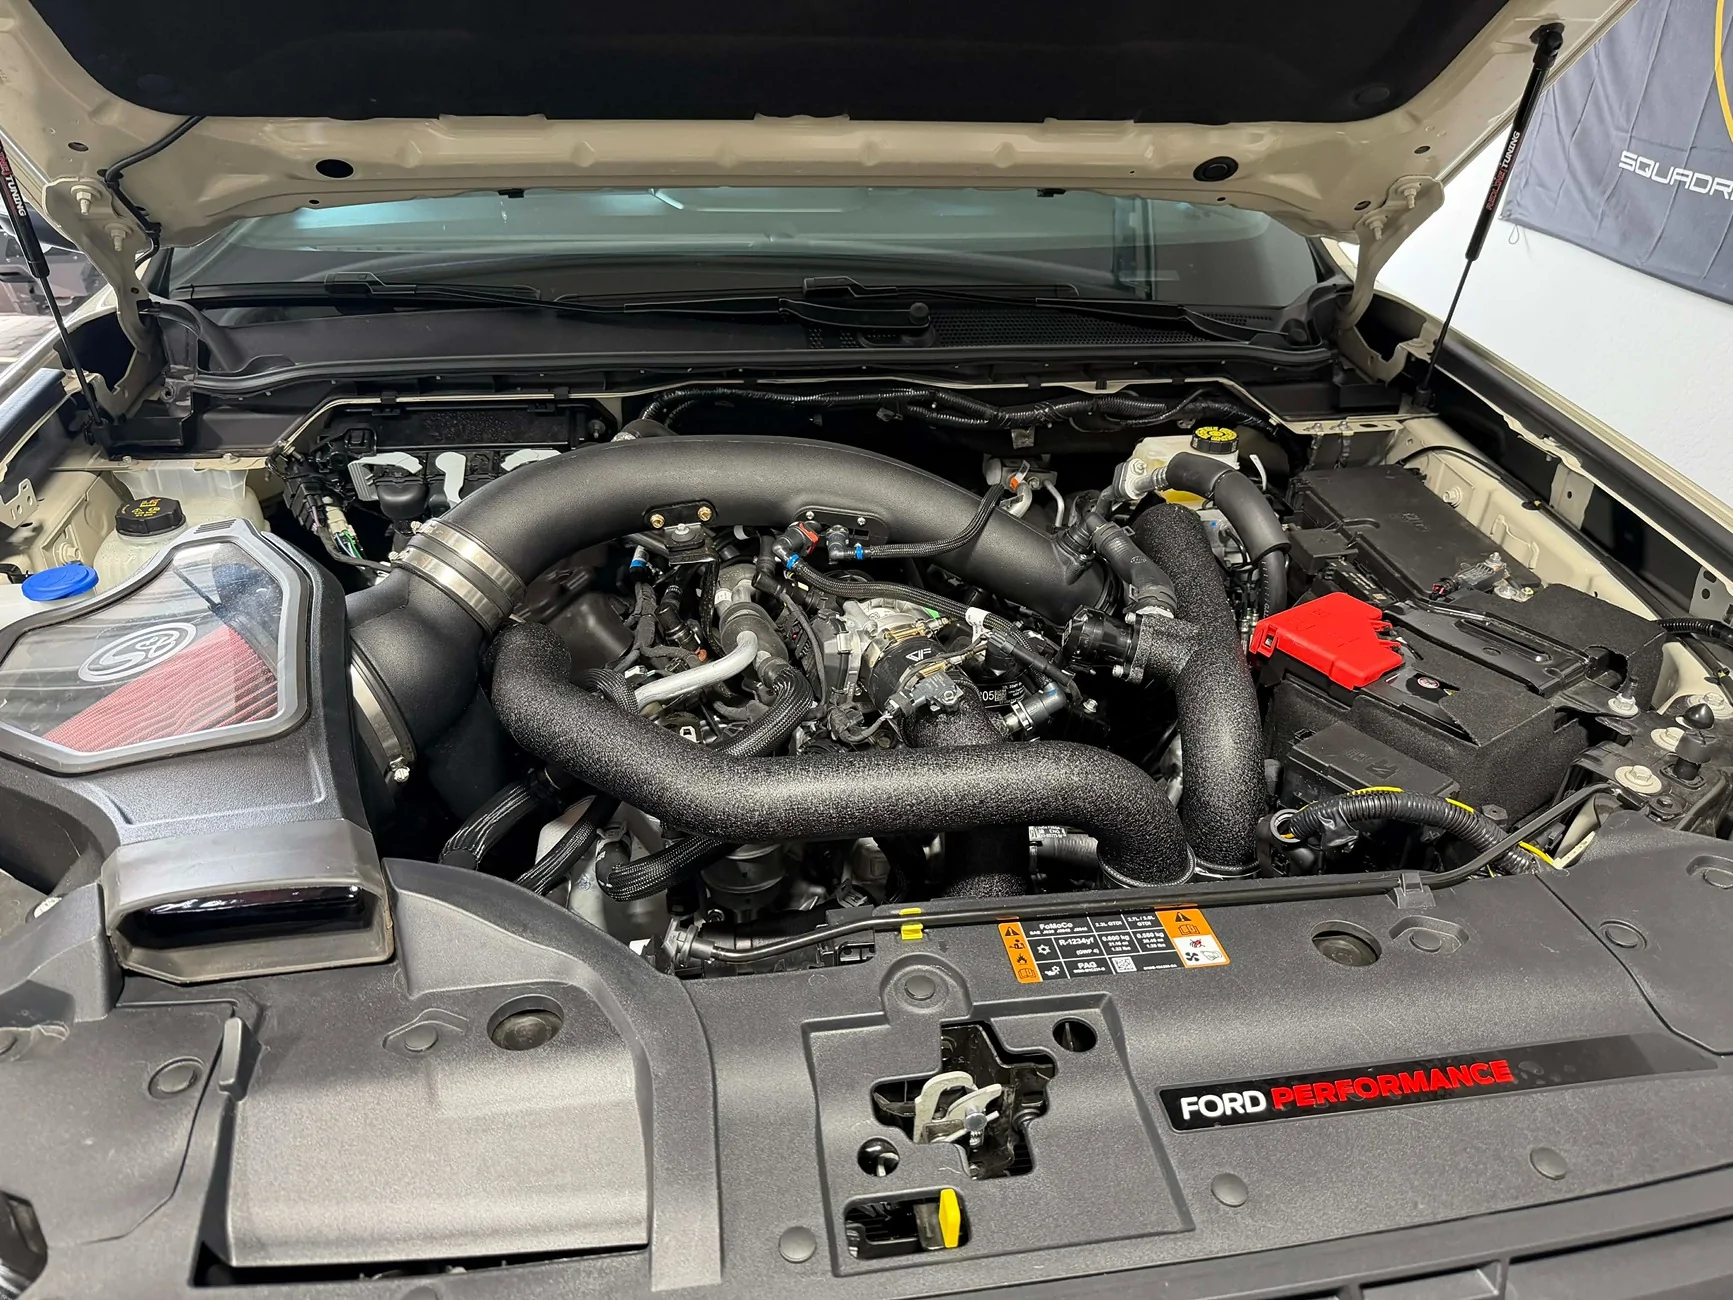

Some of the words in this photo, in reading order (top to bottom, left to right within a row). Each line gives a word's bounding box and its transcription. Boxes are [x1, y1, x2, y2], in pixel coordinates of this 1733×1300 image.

[1501, 130, 1521, 169] TUNING
[1618, 150, 1733, 201] SQUADR
[5, 174, 27, 217] TUNING
[1039, 922, 1073, 930] FoMoCo
[1058, 937, 1094, 946] R-1234yf
[1077, 961, 1097, 969] PAG
[1181, 1089, 1267, 1119] FORD
[1271, 1059, 1515, 1110] PERFORMANCE
